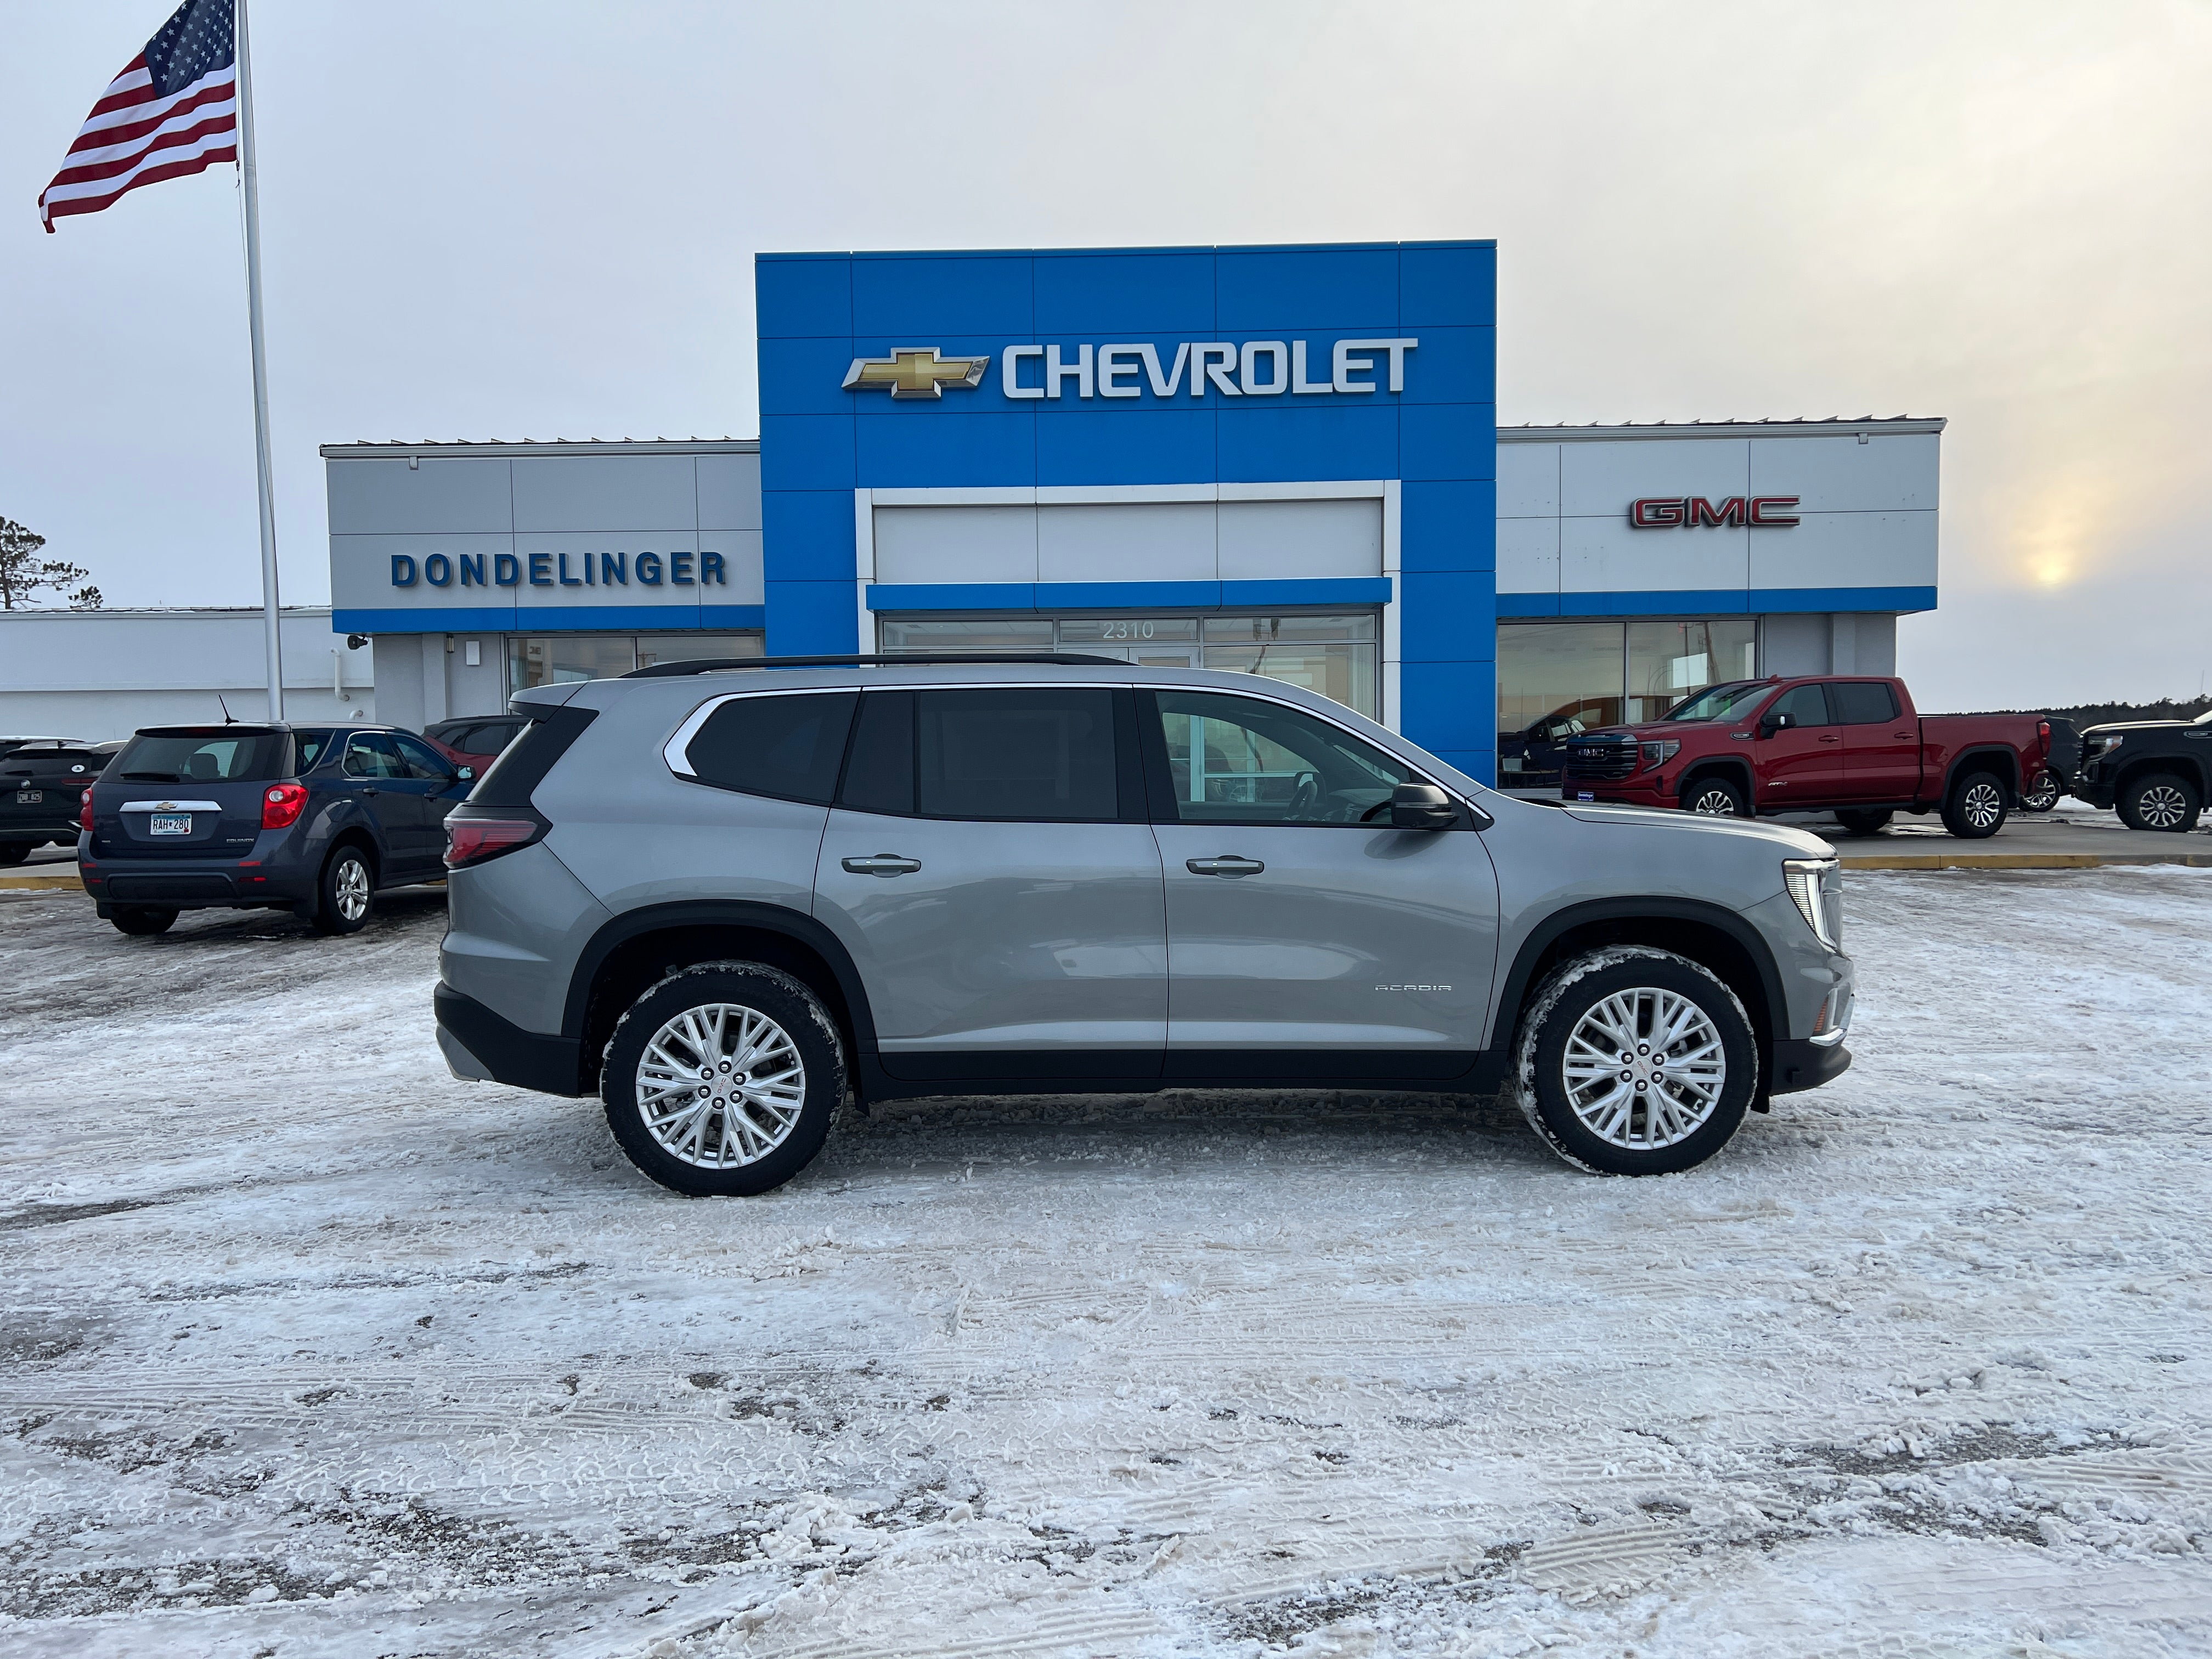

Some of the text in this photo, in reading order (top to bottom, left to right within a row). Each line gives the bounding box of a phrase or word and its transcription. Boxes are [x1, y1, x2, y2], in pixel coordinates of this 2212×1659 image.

[1002, 338, 1419, 398] CHEVROLET
[1631, 495, 1801, 527] GMC
[391, 551, 726, 586] DONDELINGER
[1103, 621, 1154, 639] 2310
[153, 819, 189, 830] RAH 280
[1637, 1060, 1649, 1075] GMC
[717, 1077, 727, 1094] GMC
